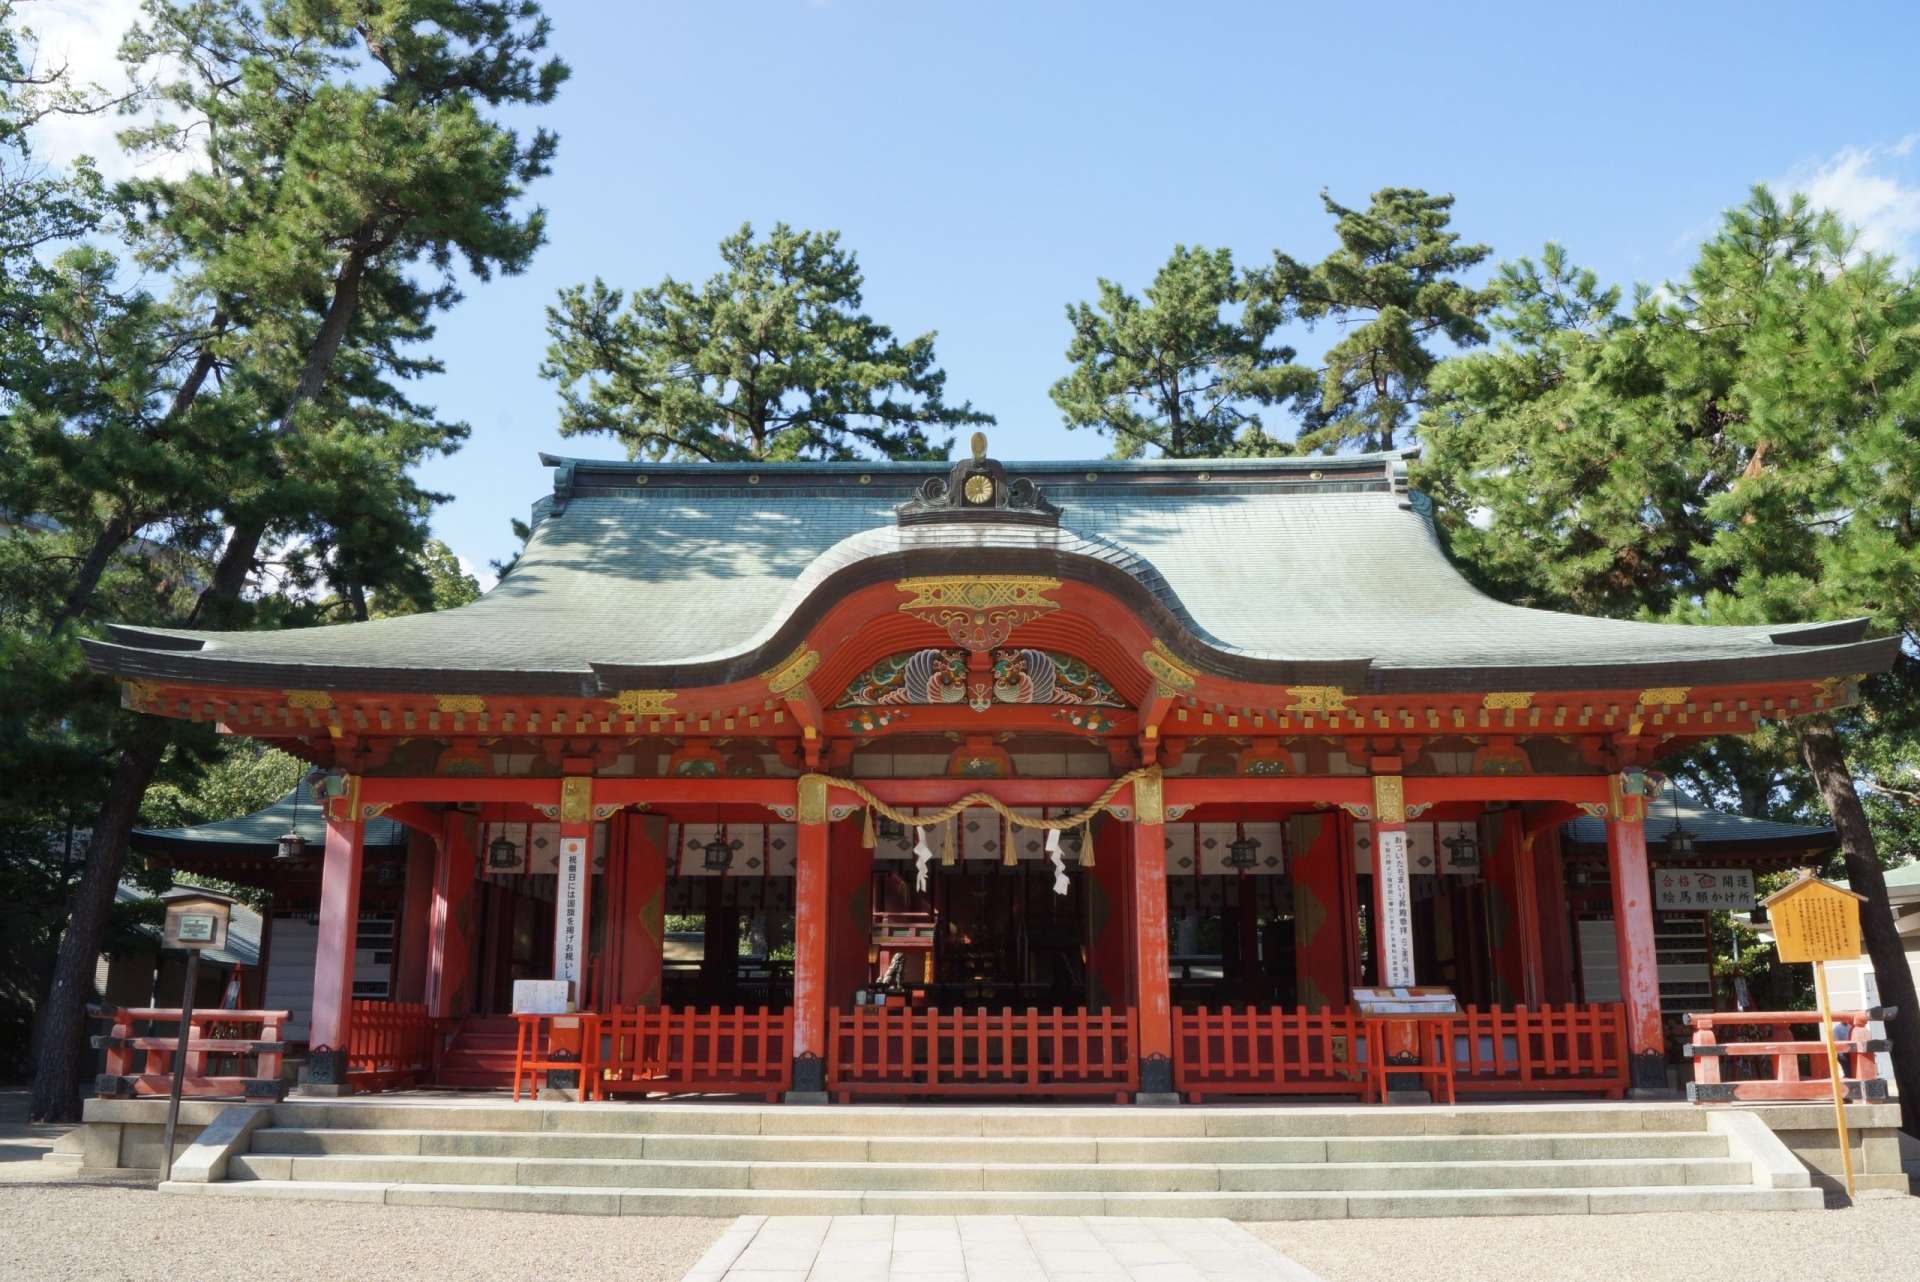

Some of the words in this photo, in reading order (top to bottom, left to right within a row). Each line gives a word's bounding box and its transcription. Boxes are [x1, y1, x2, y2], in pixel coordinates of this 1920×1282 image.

[1662, 875, 1690, 888] 合格
[1722, 875, 1750, 888] 開運
[1662, 890, 1751, 904] 絵馬願かけ所
